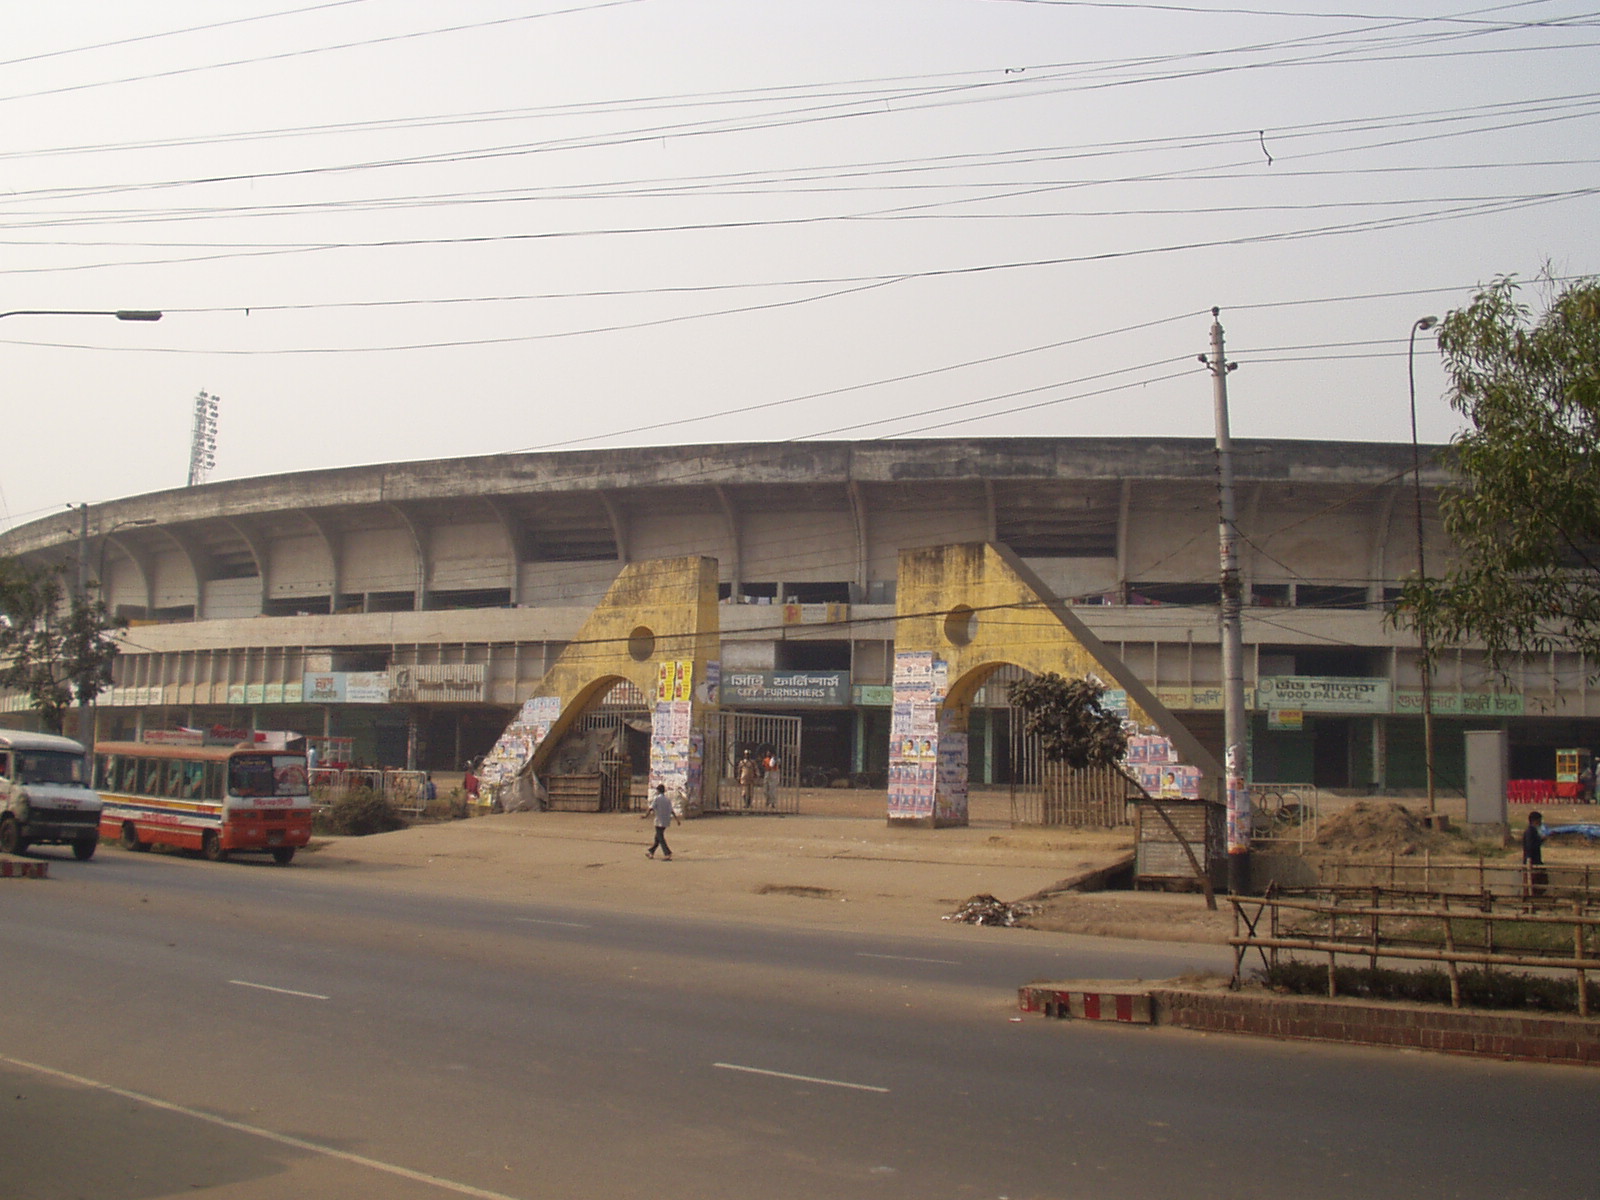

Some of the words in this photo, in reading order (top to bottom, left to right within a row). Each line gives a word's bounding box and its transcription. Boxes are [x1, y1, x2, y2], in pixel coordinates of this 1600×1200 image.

[737, 688, 758, 697] CITY
[763, 688, 825, 698] FURNISHERS
[1276, 690, 1311, 699] WOOD
[1314, 691, 1361, 700] PALACE
